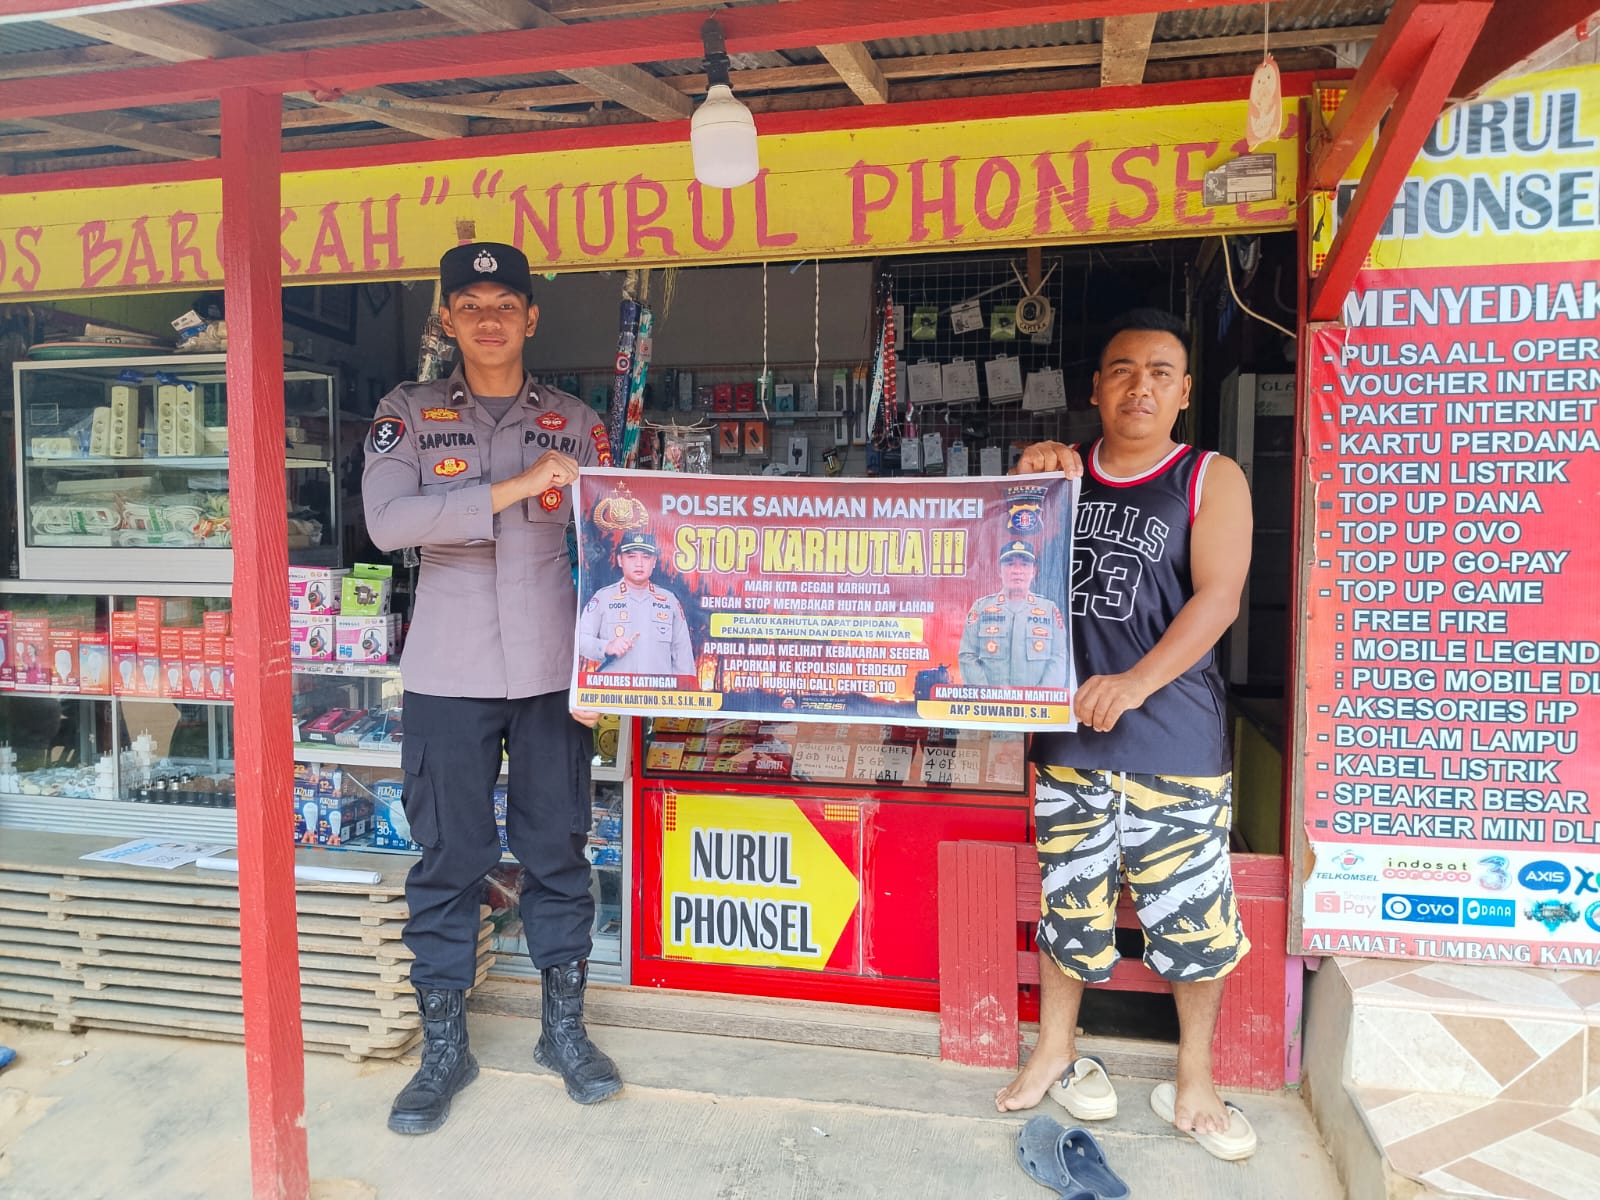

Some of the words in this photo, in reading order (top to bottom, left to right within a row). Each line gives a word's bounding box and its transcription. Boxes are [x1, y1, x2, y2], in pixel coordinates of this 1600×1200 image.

[1379, 93, 1594, 157] URUL
[1337, 171, 1600, 234] HONSE
[0, 226, 43, 292] S
[1340, 343, 1441, 367] PULSA
[1446, 341, 1505, 364] ALL
[1512, 337, 1600, 363] OPER
[1339, 371, 1488, 396] VOUCHER
[1339, 402, 1437, 426] PAKET
[1445, 398, 1598, 424] INTERNET
[419, 433, 475, 450] SAPUTRA
[524, 430, 576, 453] POLRI
[1339, 432, 1442, 455] KARTU
[1451, 429, 1600, 454] PERDANA
[1338, 462, 1441, 485] TOKEN
[1450, 459, 1571, 484] LISTRIK
[661, 494, 748, 517] POLSEK
[752, 496, 868, 518] SANAMAN
[873, 498, 984, 519] MANTIKEI
[1338, 492, 1398, 514] TOP
[1405, 491, 1447, 514] UP
[1455, 490, 1544, 514] DANA
[1337, 521, 1397, 544] TOP
[1404, 521, 1447, 544] UP
[1453, 521, 1522, 544] OVO
[675, 525, 757, 573] STOP
[762, 528, 925, 575] KARHUTLA
[931, 530, 966, 575] !!!
[1337, 551, 1397, 573] TOP
[1404, 551, 1446, 573] UP
[1453, 550, 1571, 574] GO-PAY
[744, 579, 773, 593] MARI
[775, 580, 798, 593] KITA
[800, 581, 834, 594] CEGAH
[836, 582, 890, 595] KARHUTLA
[1336, 580, 1397, 602] TOP
[1403, 580, 1445, 602] UP
[1452, 581, 1543, 603] GAME
[701, 597, 742, 609] DENGAN
[744, 597, 770, 610] STOP
[773, 598, 835, 611] MEMBAKAR
[837, 600, 871, 612] HUTAN
[875, 601, 897, 612] DAN
[899, 601, 934, 613] LAHAN
[721, 626, 763, 635] PENJARA
[765, 627, 774, 635] 15
[775, 627, 808, 636] TAHUN
[809, 628, 829, 637] DAN
[830, 629, 863, 637] DENDA
[865, 629, 874, 638] 15
[875, 630, 911, 639] MILYAR
[733, 616, 768, 625] PELAKU
[769, 617, 820, 626] KARHUTLA
[820, 618, 852, 627] DAPAT
[852, 618, 899, 628] DIPIDANA
[1352, 609, 1431, 632] FREE
[1439, 610, 1507, 633] FIRE
[703, 643, 745, 655] APABILA
[748, 643, 775, 656] ANDA
[778, 644, 823, 658] MELIHAT
[825, 645, 887, 659] KEBAKARAN
[889, 647, 930, 661] SEGERA
[1352, 638, 1466, 662] MOBILE
[1475, 641, 1600, 664] LEGEND
[723, 659, 776, 672] LAPORKAN
[779, 660, 792, 673] KE
[794, 661, 853, 675] KEPOLISIAN
[855, 663, 908, 676] TERDEKAT
[586, 675, 630, 687] KAPOLRES
[632, 676, 677, 688] KATINGAN
[734, 675, 760, 688] ATAU
[762, 677, 807, 690] HUBUNGI
[809, 678, 835, 692] CALL
[838, 680, 878, 693] CENTER
[879, 680, 896, 693] 110
[1352, 669, 1436, 691] PUBG
[1445, 669, 1561, 694] MOBILE
[580, 693, 599, 703] AKBP
[600, 694, 622, 704] DODIK
[801, 702, 846, 710] PRESISI
[935, 687, 978, 699] KAPOLSEK
[979, 688, 1023, 700] SANAMAN
[1024, 690, 1067, 702] MANTIKEI
[950, 704, 970, 715] AKP
[1030, 707, 1051, 718] S.H.
[1333, 696, 1527, 722] AKSESORIES
[1535, 701, 1578, 723] HP
[860, 746, 909, 755] VOUCHER
[1335, 725, 1463, 749] BOHLAM
[1471, 728, 1578, 754] LAMPU
[925, 759, 935, 769] 4
[927, 748, 978, 757] VOUCHER
[1335, 754, 1435, 780] KABEL
[1442, 757, 1562, 784] LISTRIK
[1334, 783, 1477, 811] SPEAKER
[1483, 788, 1590, 814] BESAR
[1333, 812, 1477, 840] SPEAKER
[1482, 817, 1545, 842] MINI
[693, 830, 797, 885] NURUL
[1388, 857, 1468, 870] indosat
[1316, 872, 1380, 881] TELKOMSEL
[1384, 869, 1470, 882] ooredoo
[1525, 870, 1565, 882] AXIS
[1344, 900, 1376, 918] Pay
[1482, 905, 1511, 917] DANA
[674, 896, 818, 954] PHONSEL
[1308, 933, 1406, 955] ALAMAT:
[1414, 938, 1531, 963] TUMBANG
